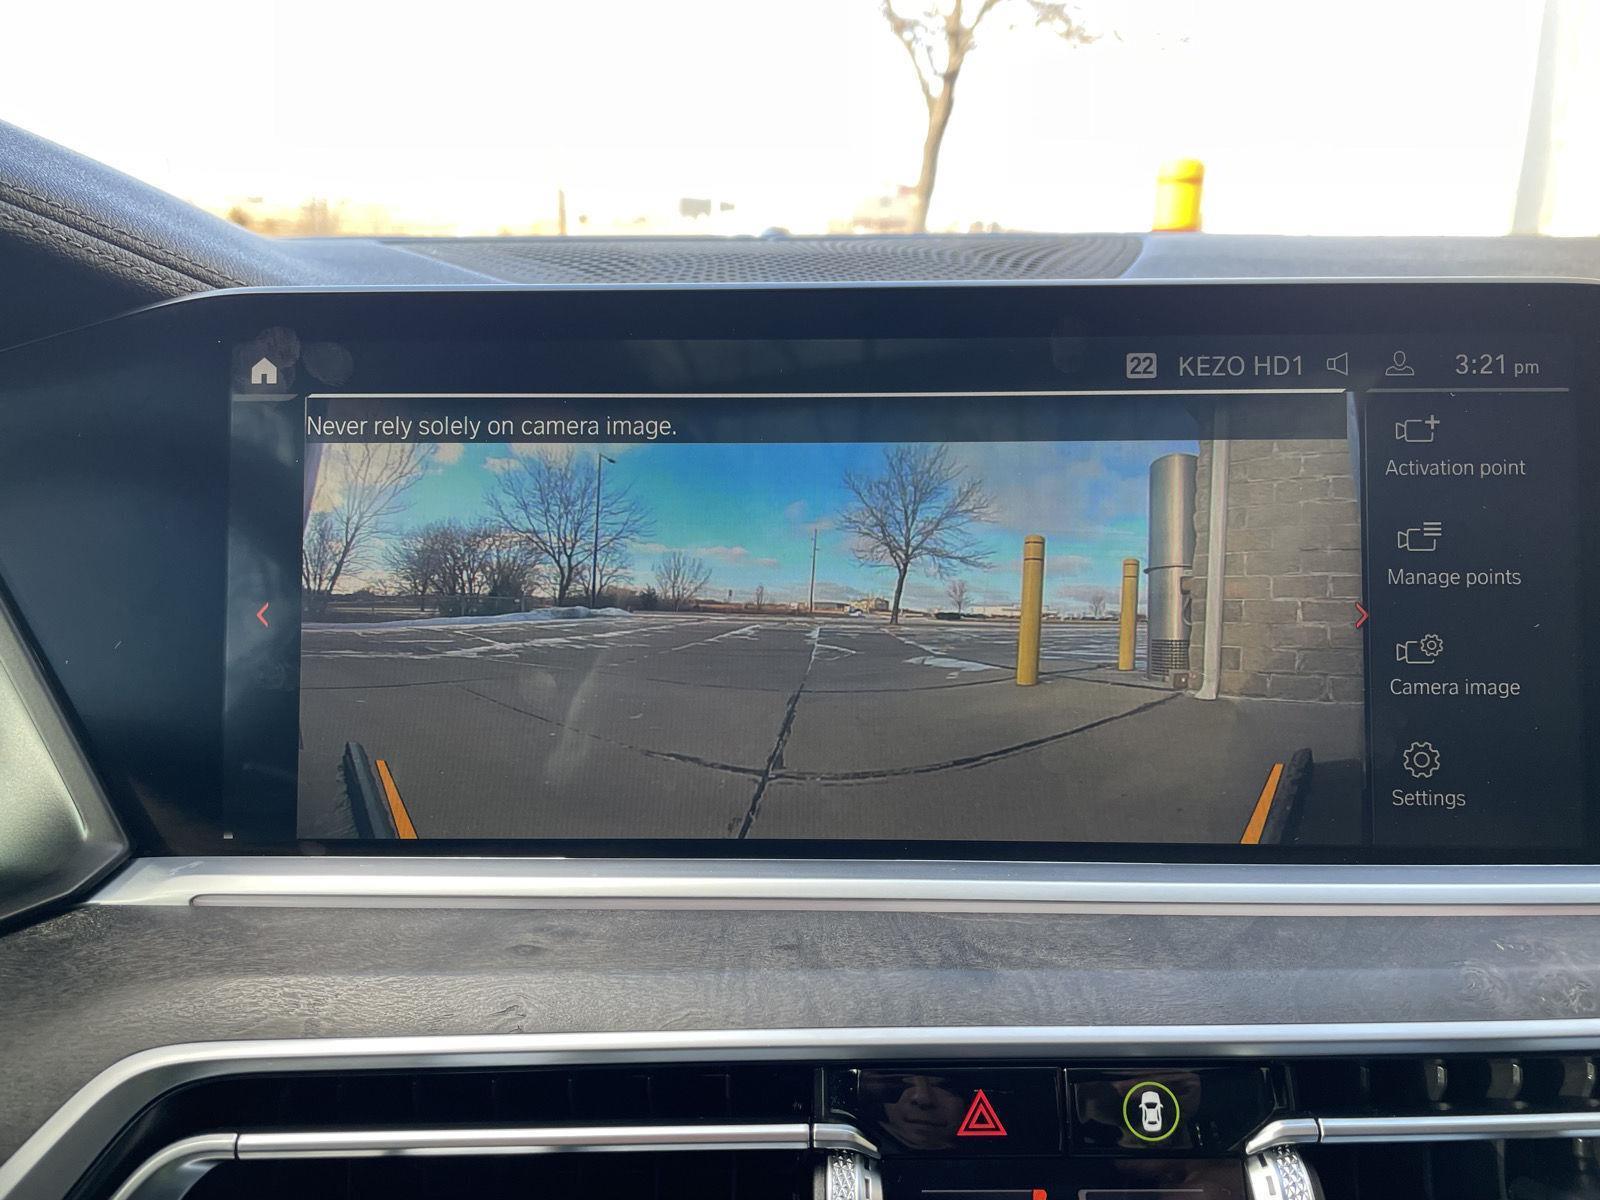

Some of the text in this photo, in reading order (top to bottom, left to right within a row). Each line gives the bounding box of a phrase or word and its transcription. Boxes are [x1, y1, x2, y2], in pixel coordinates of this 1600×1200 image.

[1129, 355, 1154, 376] 22
[1179, 355, 1303, 377] KEZO HD1
[1455, 353, 1540, 377] 3:21 pm
[306, 415, 677, 440] Never rely solely on camera image.
[1385, 459, 1526, 480] Activation point
[1387, 568, 1522, 588] Manage points
[1390, 678, 1521, 699] Camera image
[1391, 789, 1466, 810] Settings
